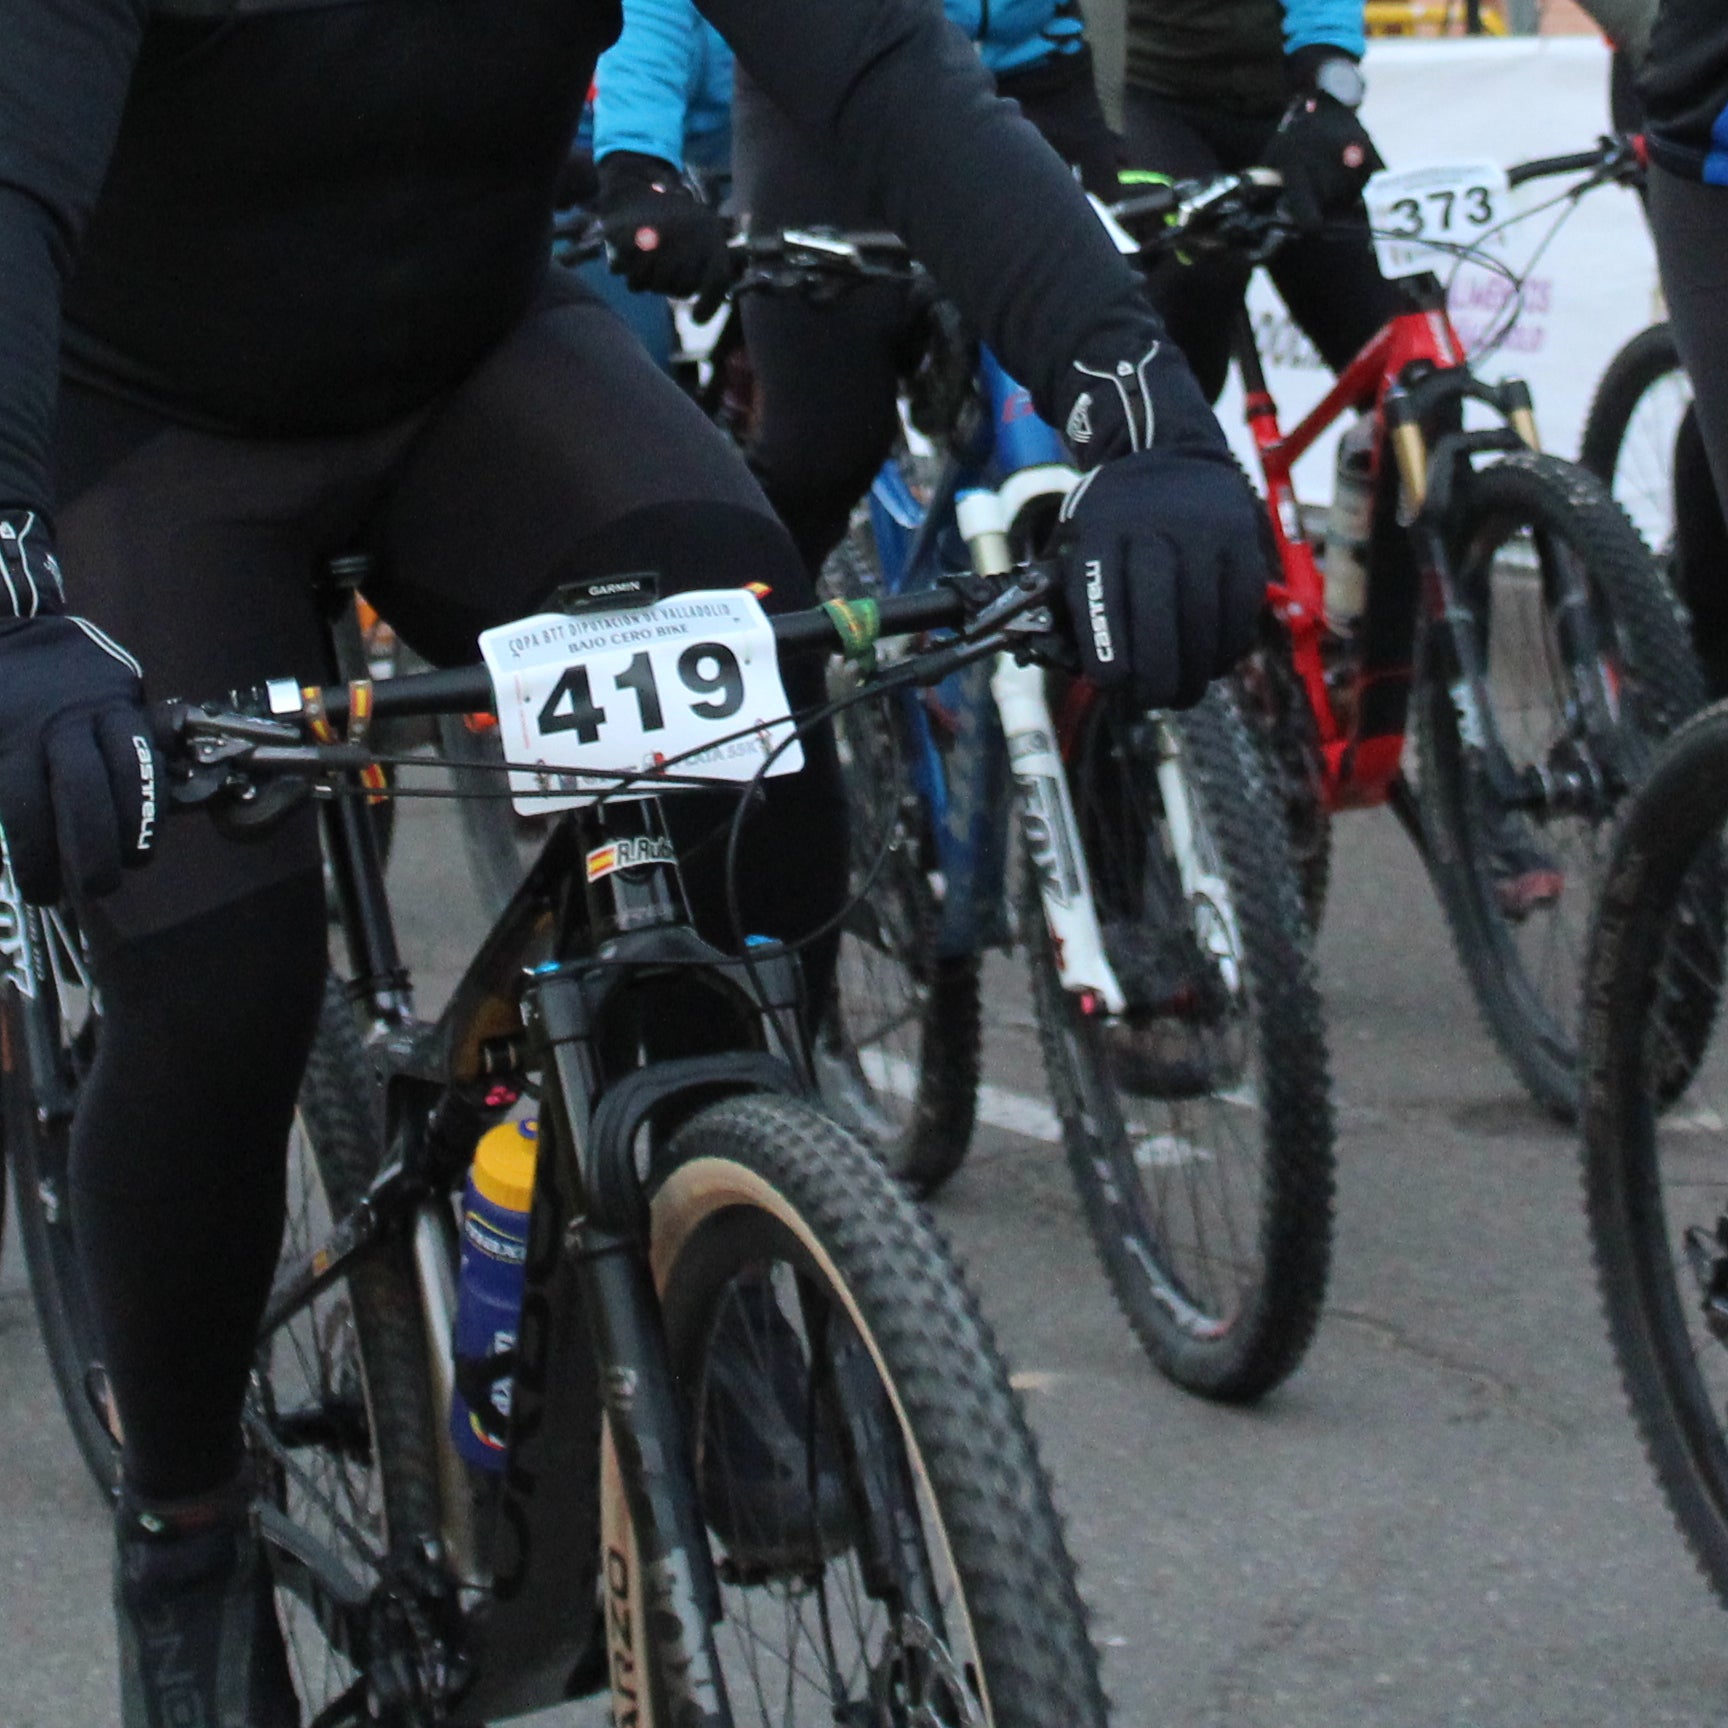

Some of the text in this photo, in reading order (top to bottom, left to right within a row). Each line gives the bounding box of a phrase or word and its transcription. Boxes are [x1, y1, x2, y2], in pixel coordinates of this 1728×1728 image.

[1390, 186, 1493, 237] 373
[587, 580, 641, 596] GARMIN
[508, 603, 731, 655] COPA BTT DIPUTACIÓN DE VALLADOLID
[567, 623, 690, 654] BAJO CERO BIKE
[536, 641, 746, 746] 419
